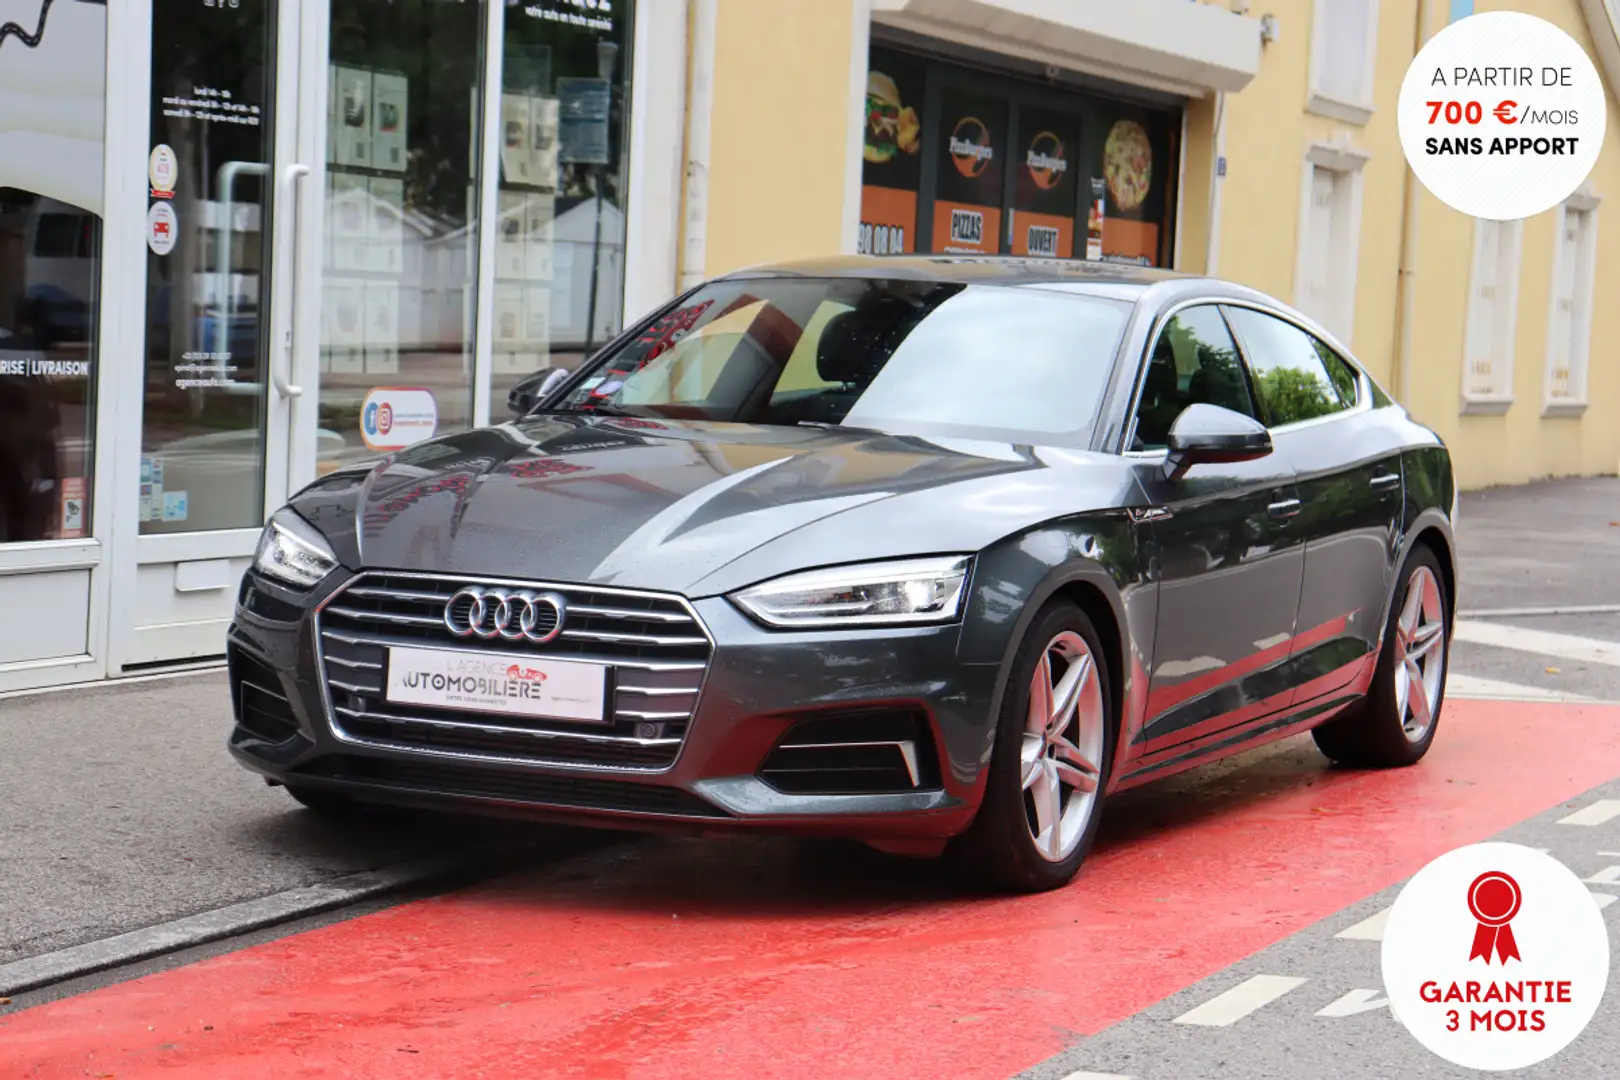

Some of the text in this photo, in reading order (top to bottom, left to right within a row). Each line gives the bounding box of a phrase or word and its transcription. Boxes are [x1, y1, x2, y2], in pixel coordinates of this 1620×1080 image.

[951, 212, 982, 242] PIZZAS
[1028, 228, 1057, 253] OUVERT
[32, 360, 88, 376] LIVRAISON
